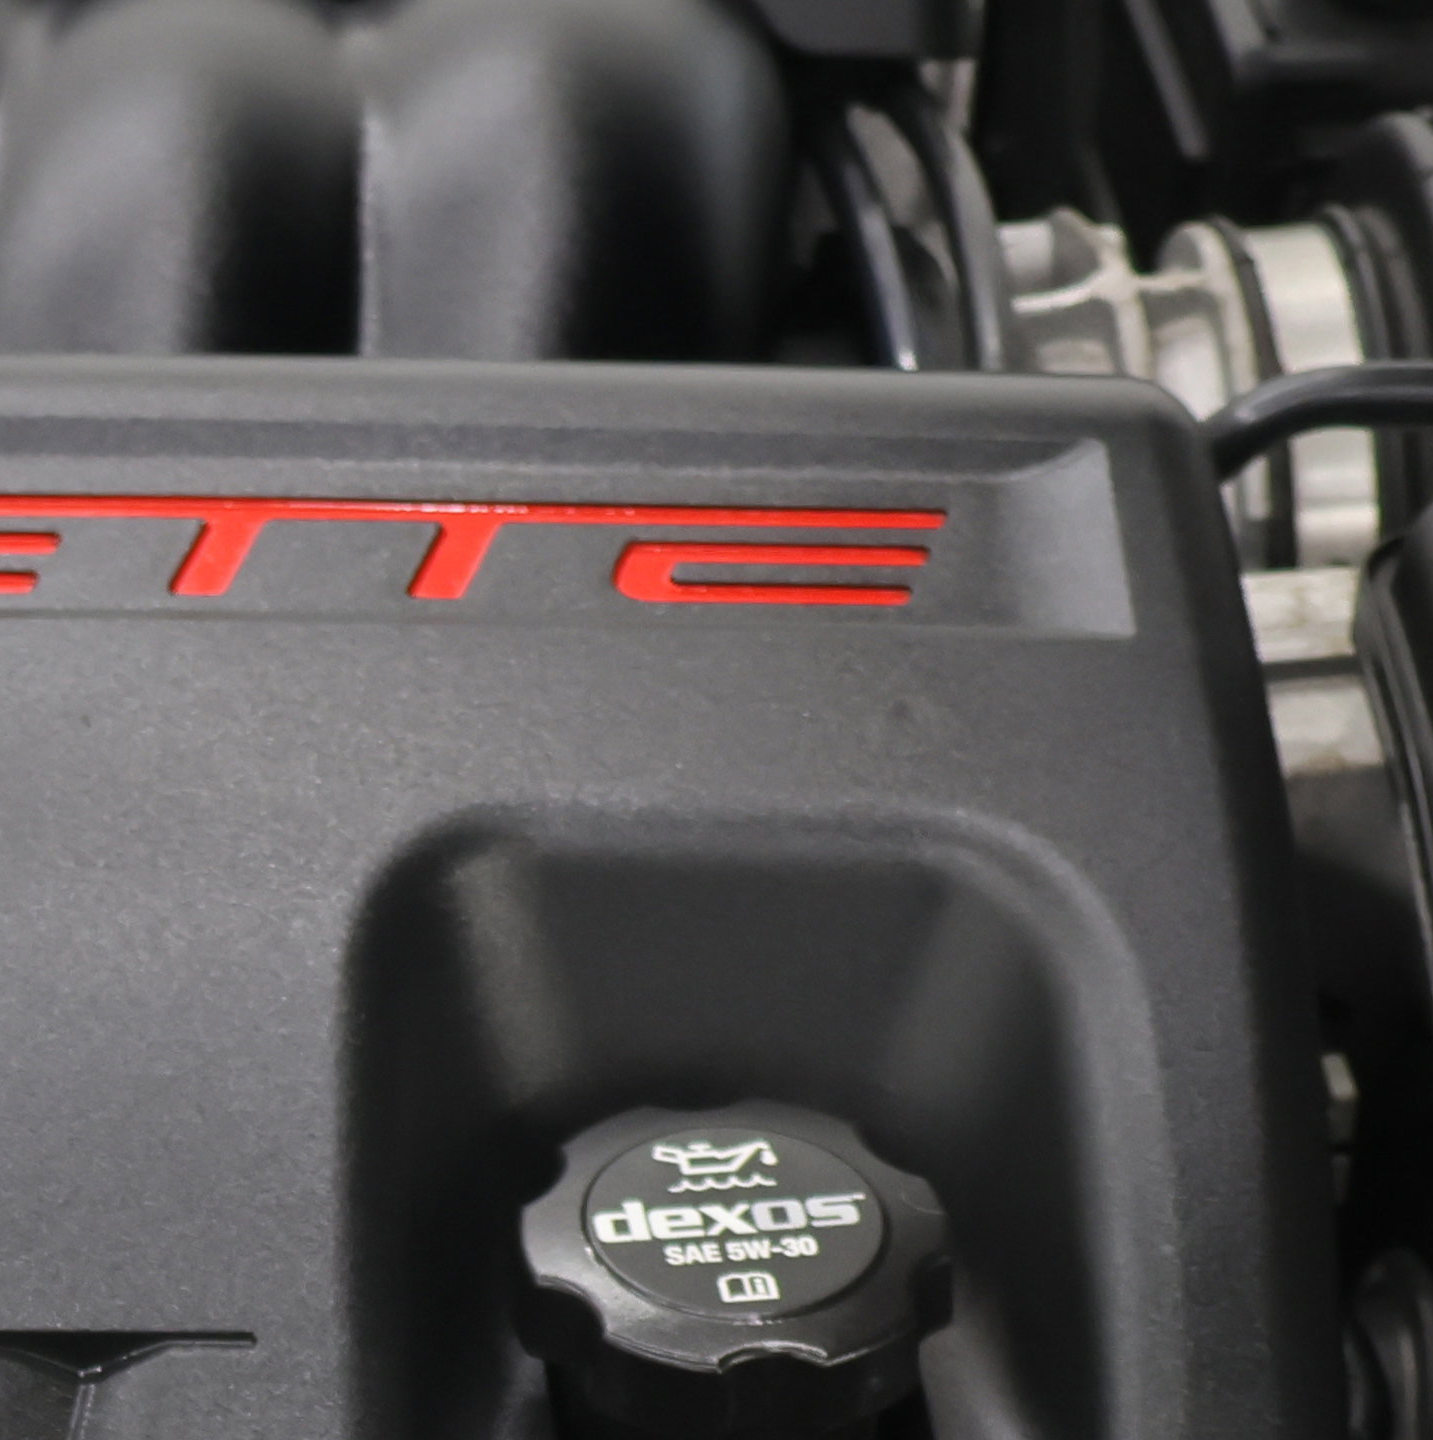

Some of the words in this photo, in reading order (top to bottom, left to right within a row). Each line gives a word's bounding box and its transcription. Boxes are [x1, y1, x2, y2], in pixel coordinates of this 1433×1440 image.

[592, 1192, 867, 1244] dexos
[663, 1244, 723, 1266] SAE
[725, 1235, 819, 1261] 5W-30
